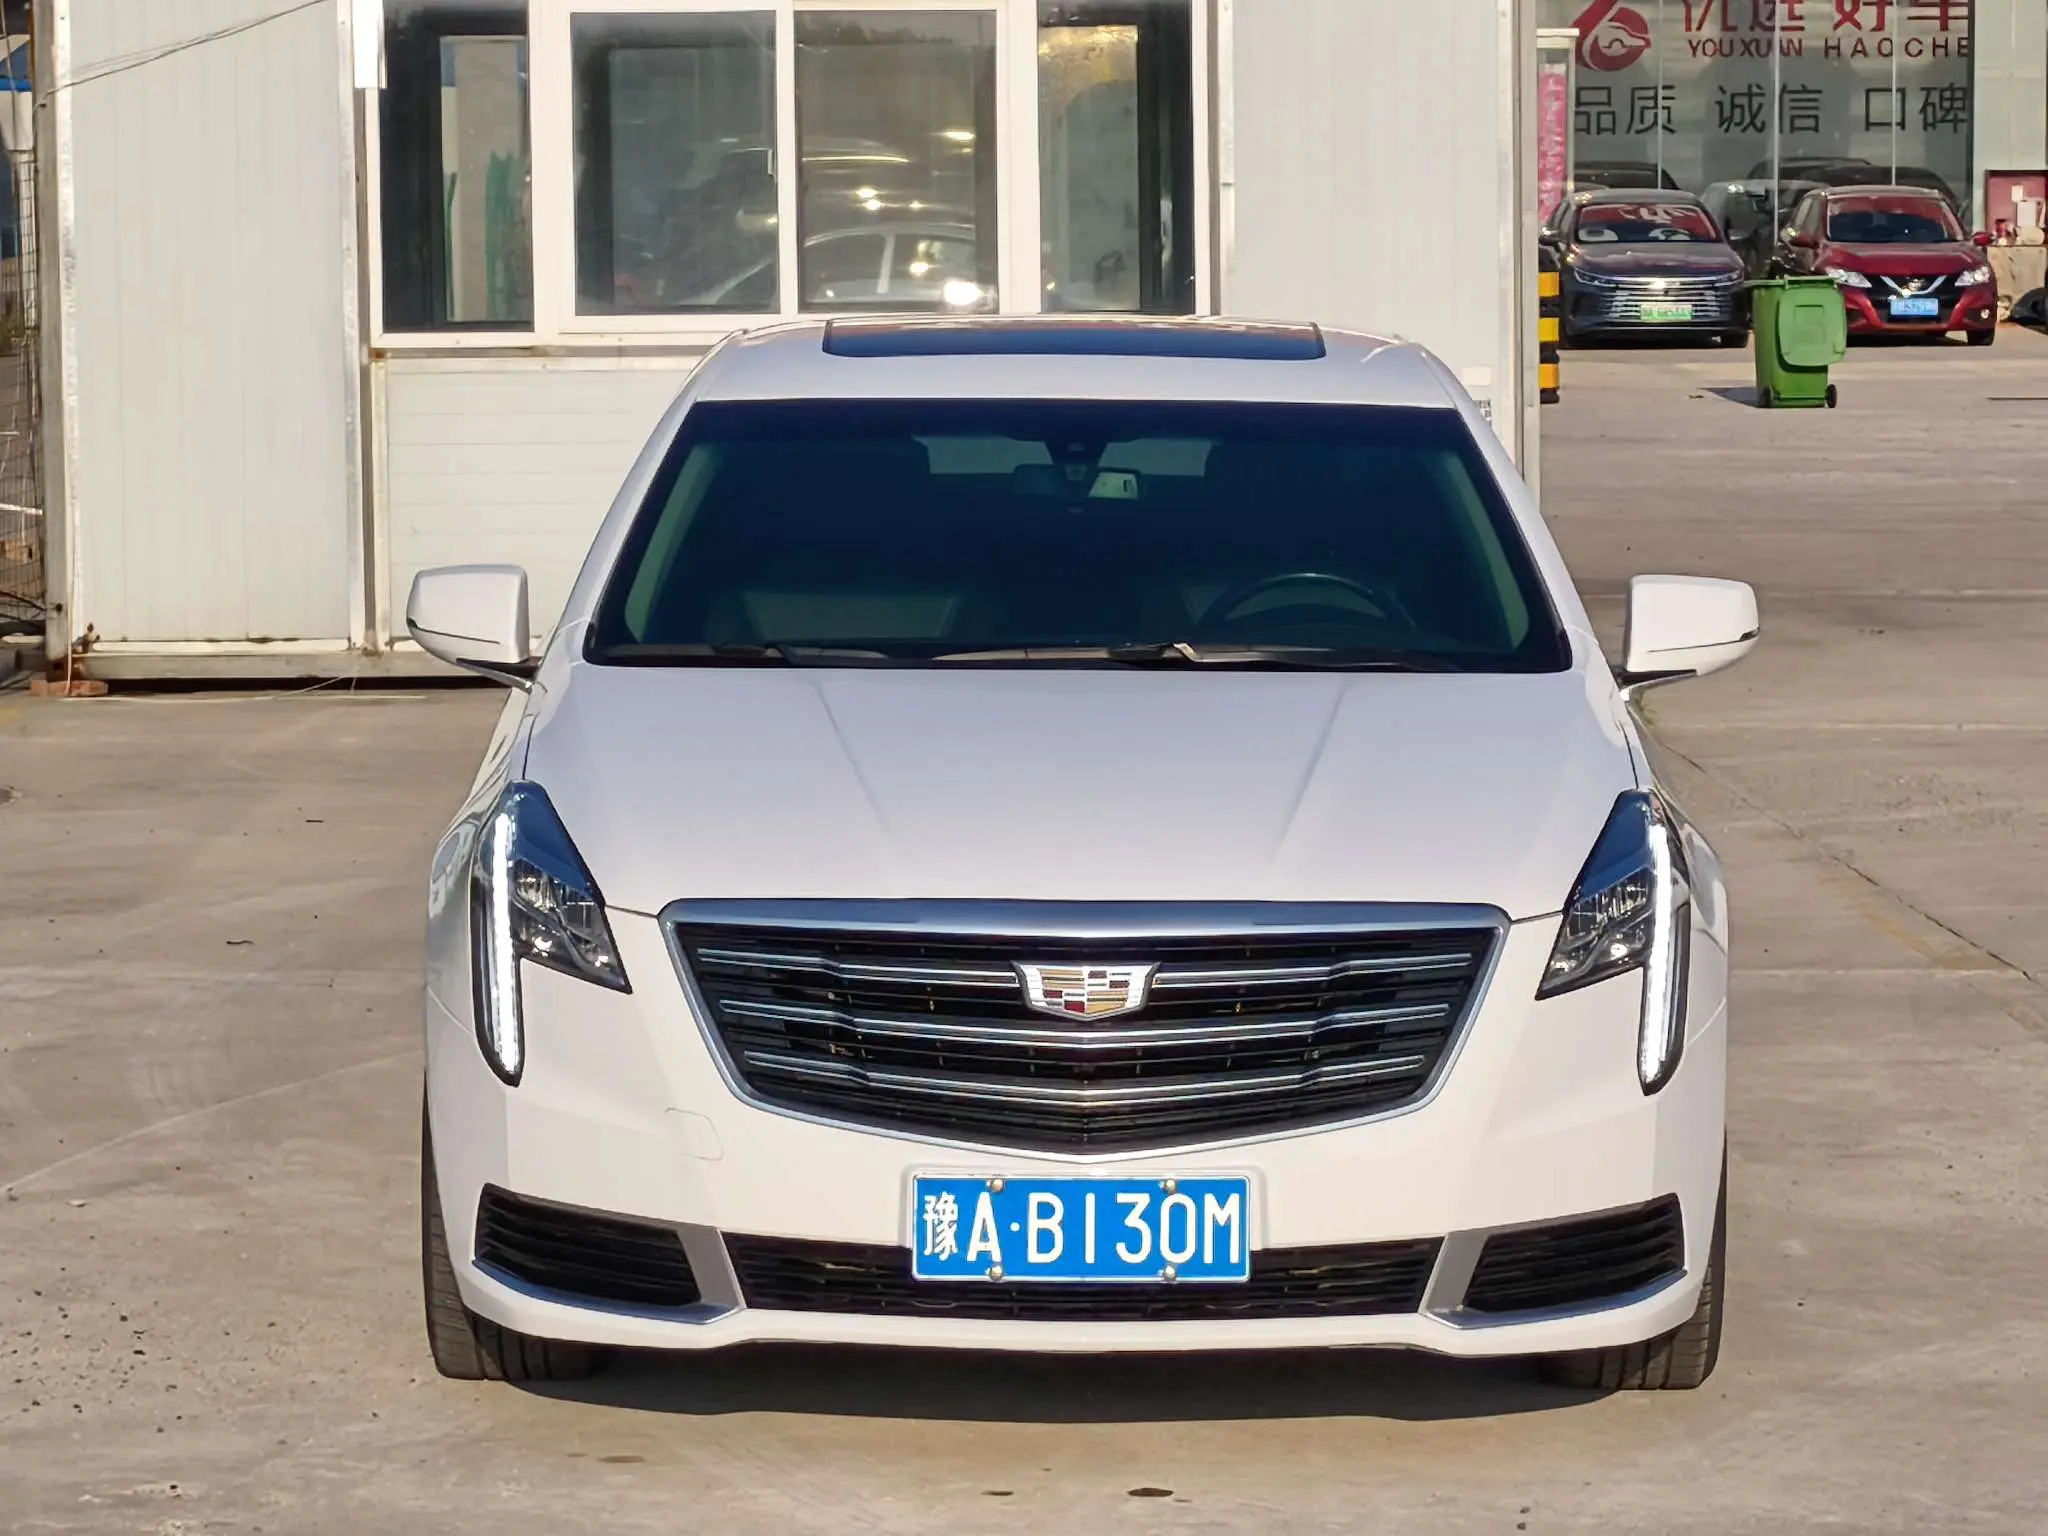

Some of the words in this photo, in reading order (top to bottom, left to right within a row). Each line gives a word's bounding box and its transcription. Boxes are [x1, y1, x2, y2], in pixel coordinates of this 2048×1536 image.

[1575, 85, 1677, 135] 品质
[1714, 82, 1823, 135] 诚信
[1864, 81, 1969, 134] 口碑
